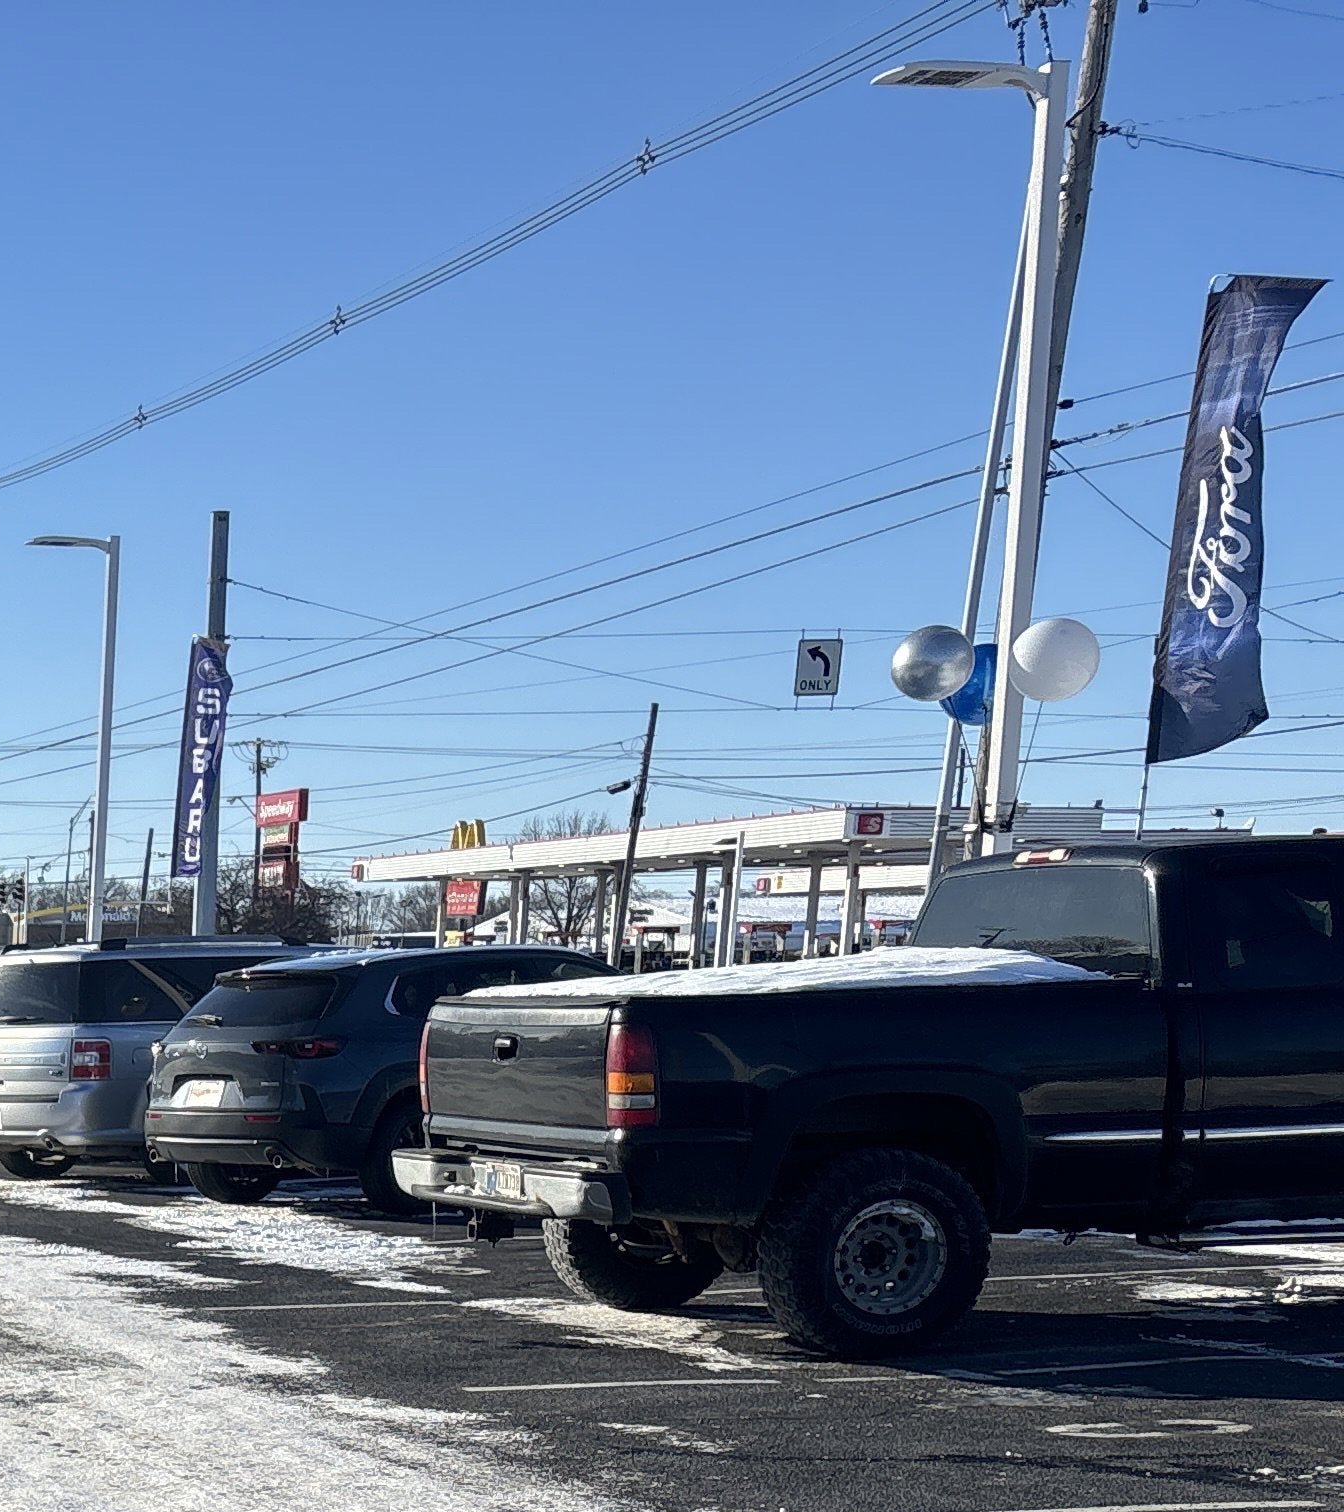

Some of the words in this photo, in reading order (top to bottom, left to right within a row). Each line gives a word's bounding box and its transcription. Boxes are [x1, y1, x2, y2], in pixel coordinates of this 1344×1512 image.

[799, 679, 832, 691] ONLY
[184, 687, 221, 863] SUBARU
[70, 909, 139, 922] Mcnalds
